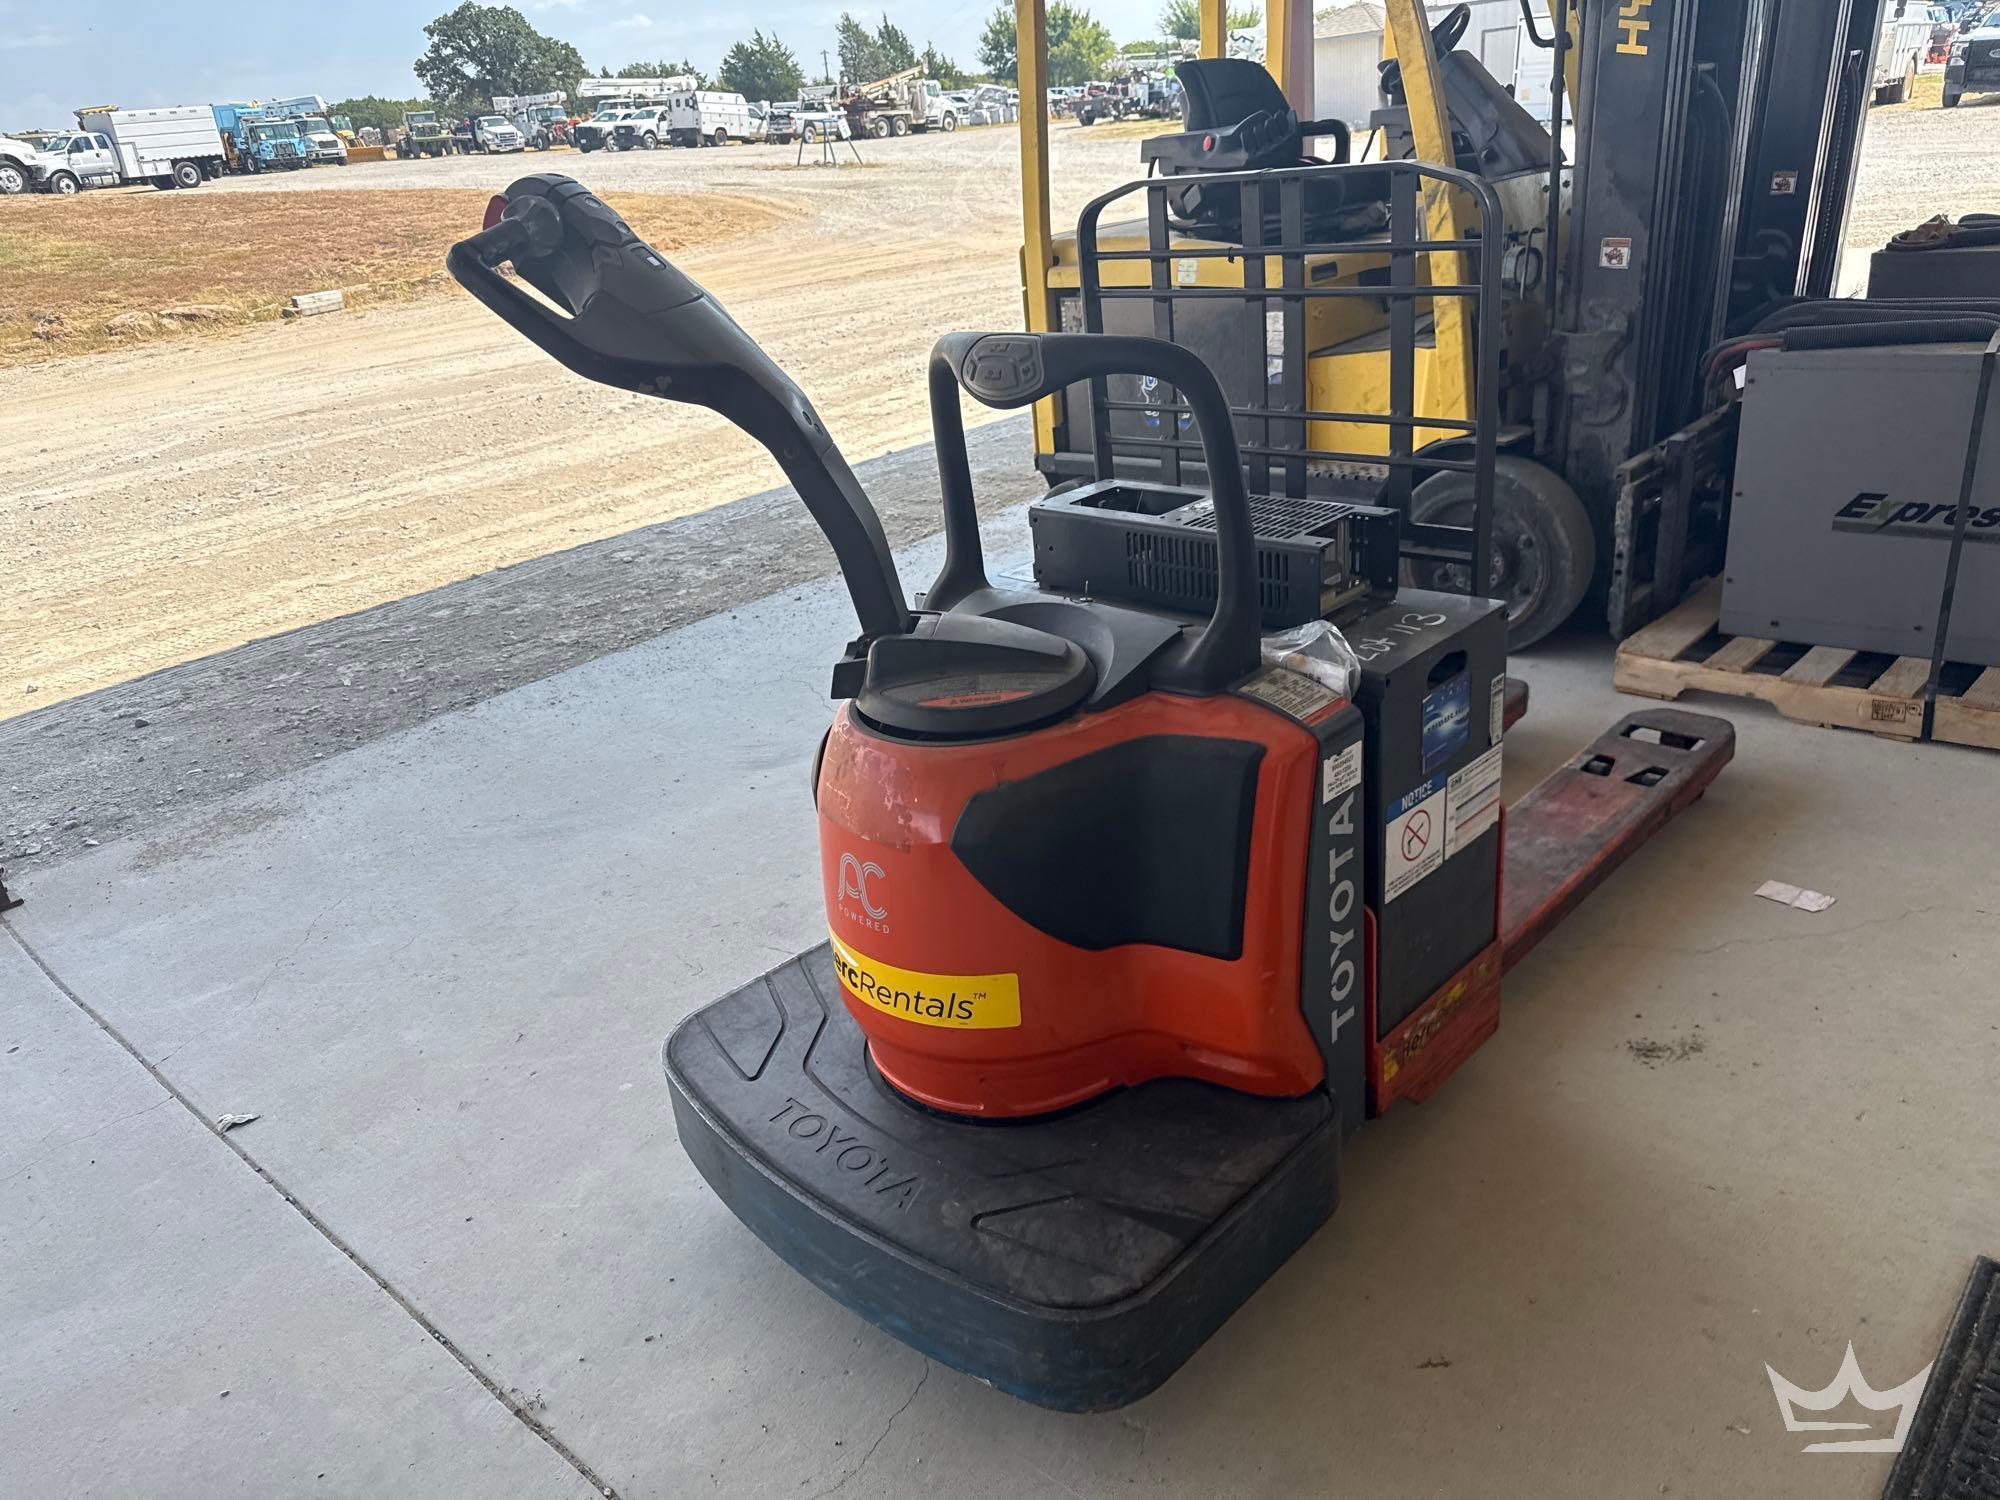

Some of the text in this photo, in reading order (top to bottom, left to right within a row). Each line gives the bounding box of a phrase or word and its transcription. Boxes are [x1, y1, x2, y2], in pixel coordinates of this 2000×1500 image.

[1834, 492, 2000, 533] Expres
[1386, 613, 1447, 635] 113
[1402, 779, 1433, 811] NOTICE
[838, 852, 888, 920] AC
[838, 903, 890, 934] POWERED
[1329, 791, 1355, 1043] TOYOTA
[768, 1097, 924, 1216] TOYOTA
